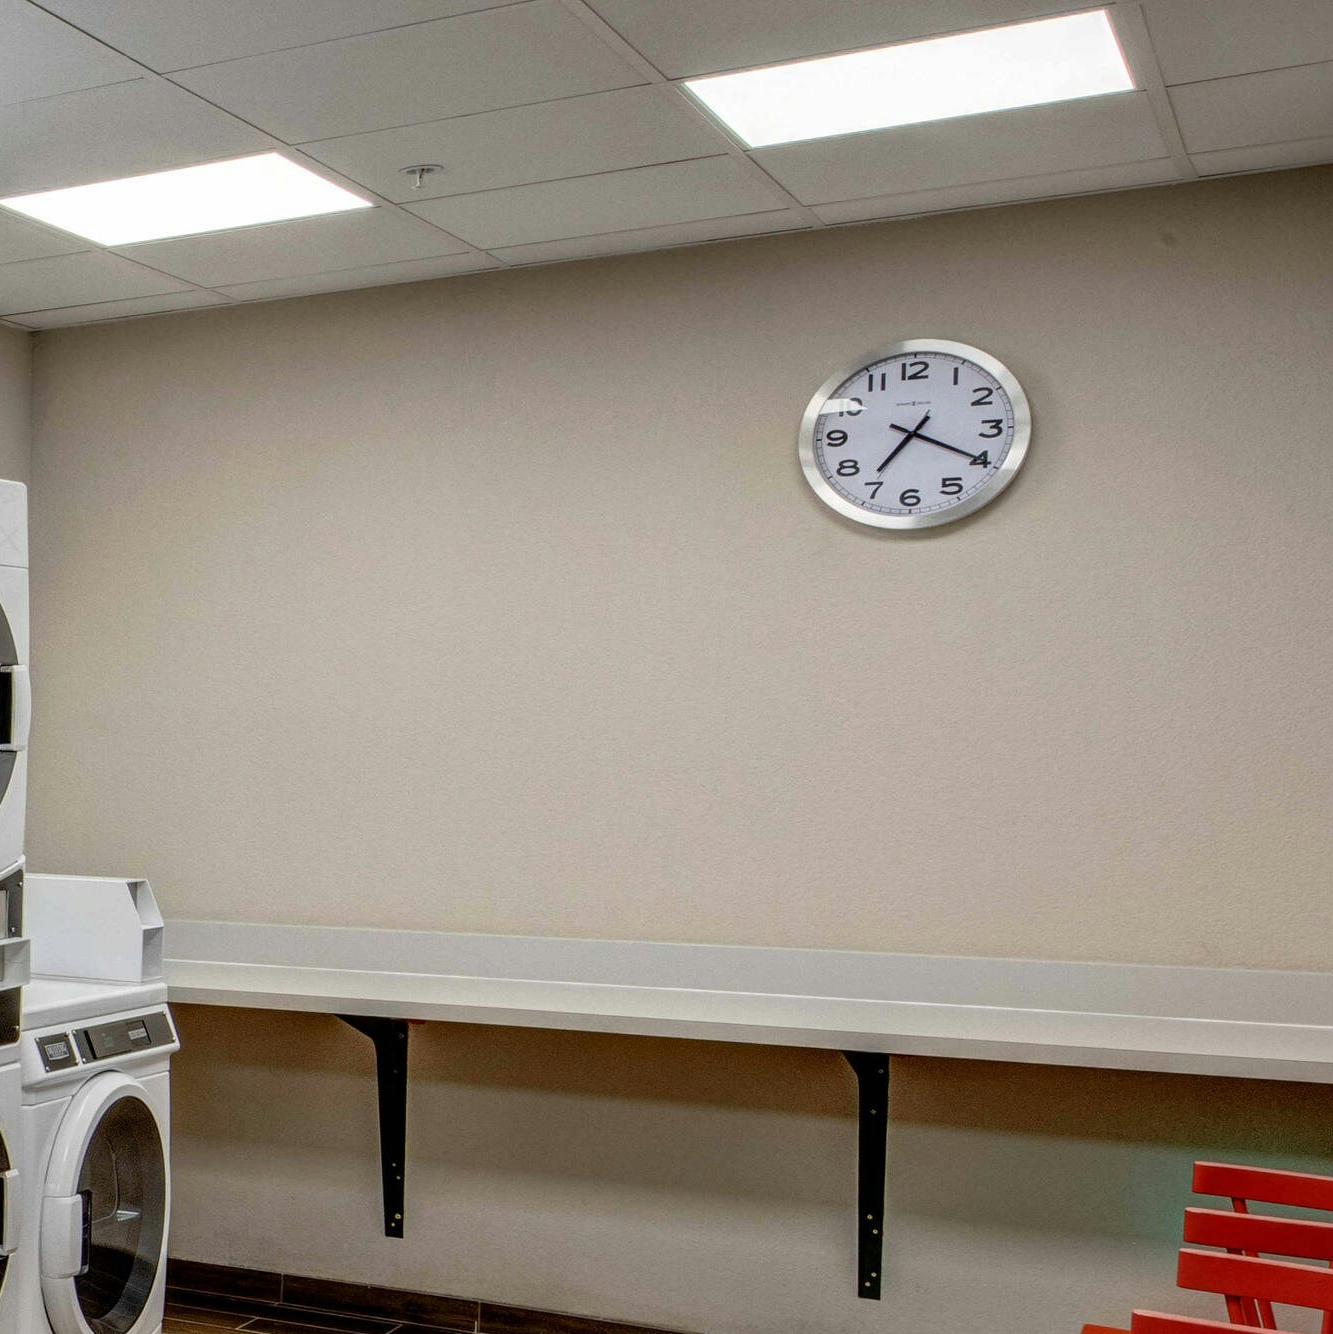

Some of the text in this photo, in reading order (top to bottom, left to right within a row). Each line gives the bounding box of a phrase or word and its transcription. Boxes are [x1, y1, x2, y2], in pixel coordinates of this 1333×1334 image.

[901, 361, 929, 381] 12
[953, 367, 959, 385] 1
[868, 373, 886, 392] 11
[971, 387, 993, 406] 2
[838, 397, 864, 416] 0
[978, 419, 1003, 438] 3
[826, 430, 848, 447] 9
[836, 459, 860, 476] 8
[969, 451, 991, 468] 4
[864, 481, 884, 499] 7
[939, 477, 963, 495] 5
[899, 489, 921, 506] 6
